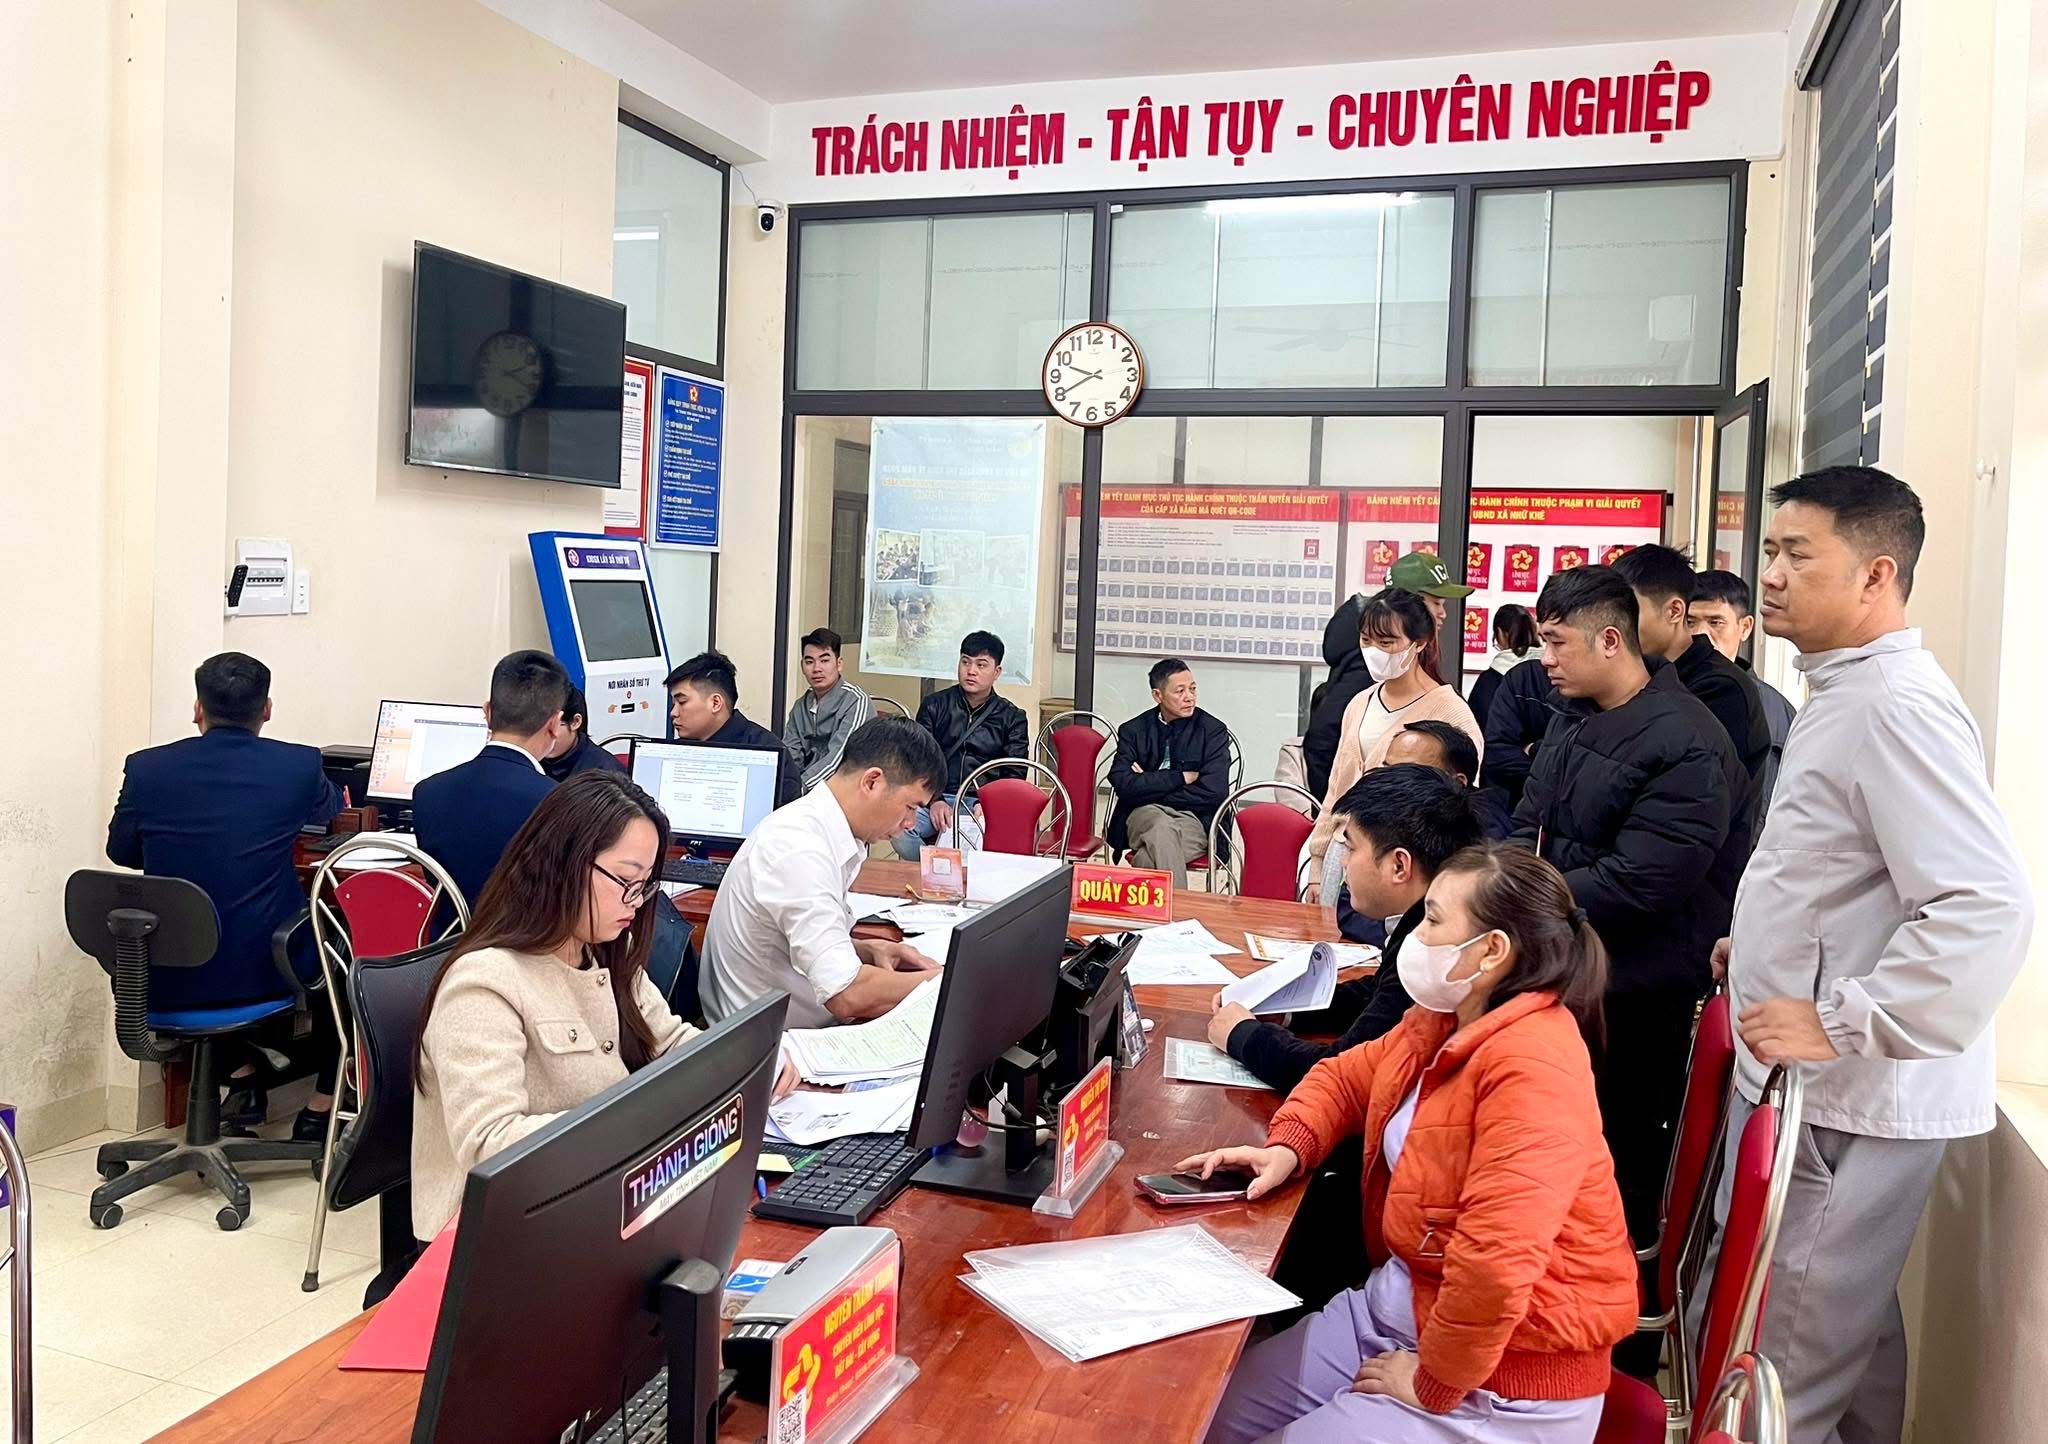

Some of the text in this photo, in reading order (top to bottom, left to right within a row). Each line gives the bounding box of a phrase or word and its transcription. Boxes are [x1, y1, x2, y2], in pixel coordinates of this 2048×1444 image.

[812, 60, 1710, 180] TRÁCH NHIỆM - TẬN TỤY - CHUYÊN NGHIỆP
[1070, 335, 1082, 351] 11
[1086, 329, 1103, 345] 12
[1111, 333, 1117, 349] 1
[1056, 351, 1072, 366] 10
[1121, 347, 1133, 363] 2
[1050, 369, 1061, 383] 9
[1127, 367, 1138, 382] 3
[1055, 387, 1066, 401] 8
[1120, 386, 1131, 401] 4
[1069, 401, 1081, 417] 7
[1086, 406, 1098, 421] 6
[1104, 401, 1116, 416] 5
[1480, 496, 1501, 507] HÀNH
[1503, 496, 1528, 508] CHÍNH
[1531, 498, 1557, 510] THUỘC
[1559, 499, 1584, 510] PHẠM
[1586, 500, 1594, 508] VI
[1596, 497, 1613, 509] GIẢI
[1615, 496, 1641, 509] QUYẾT
[1473, 511, 1495, 520] UBND
[1127, 878, 1150, 906] SỐ
[1154, 888, 1165, 908] 3
[628, 1107, 738, 1208] THÁNH GIÓNG
